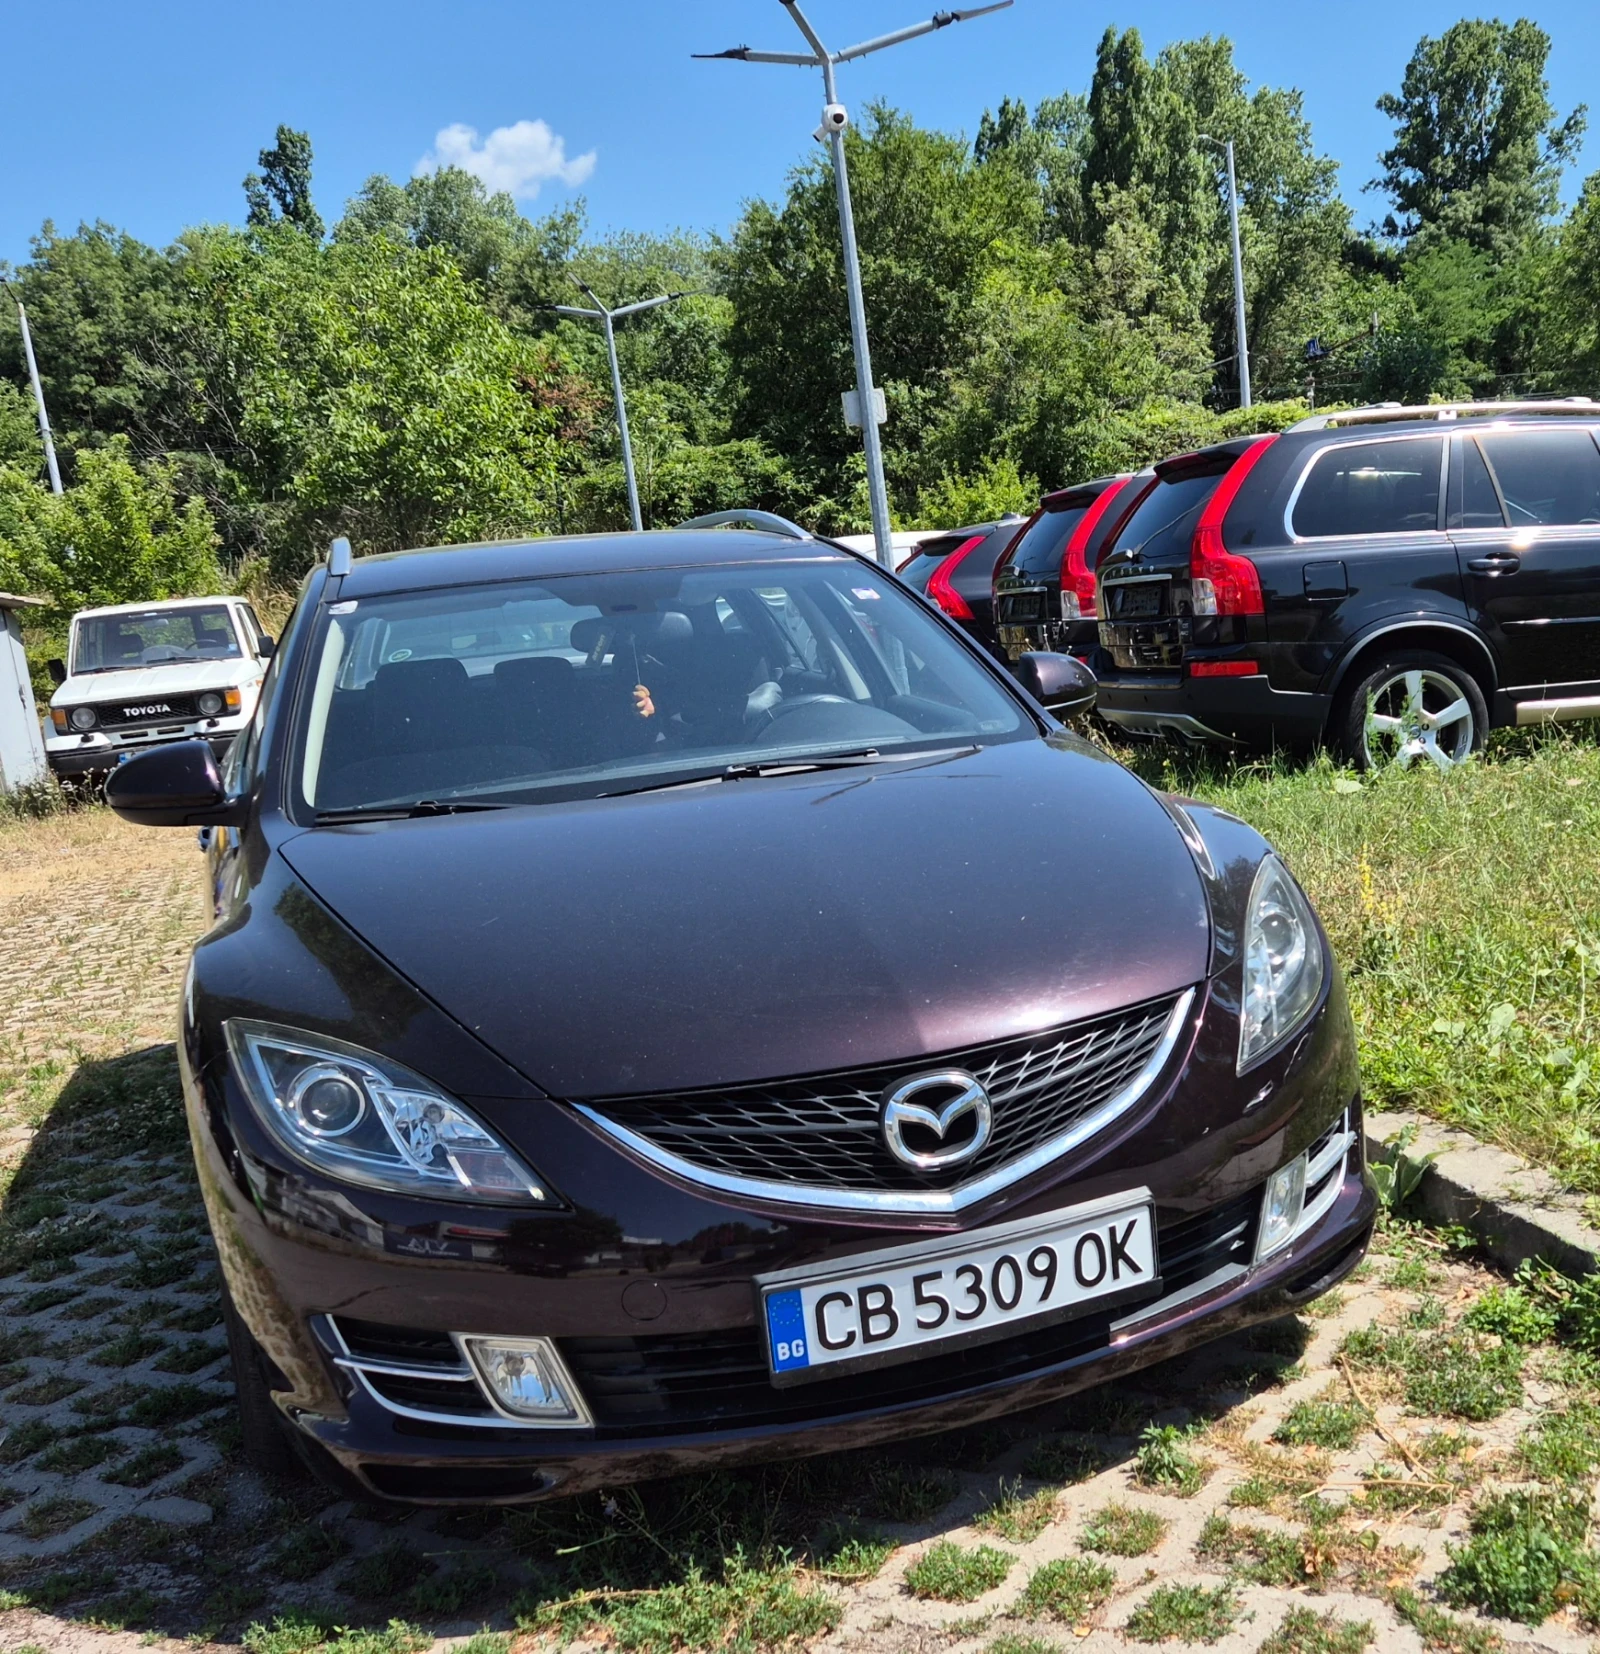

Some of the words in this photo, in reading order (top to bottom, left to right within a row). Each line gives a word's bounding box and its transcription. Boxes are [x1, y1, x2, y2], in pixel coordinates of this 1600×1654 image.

[123, 704, 171, 717] TOYOTA
[814, 1283, 899, 1350] CB
[912, 1245, 1058, 1330] 5309
[1074, 1218, 1143, 1288] OK
[777, 1339, 804, 1361] BG
